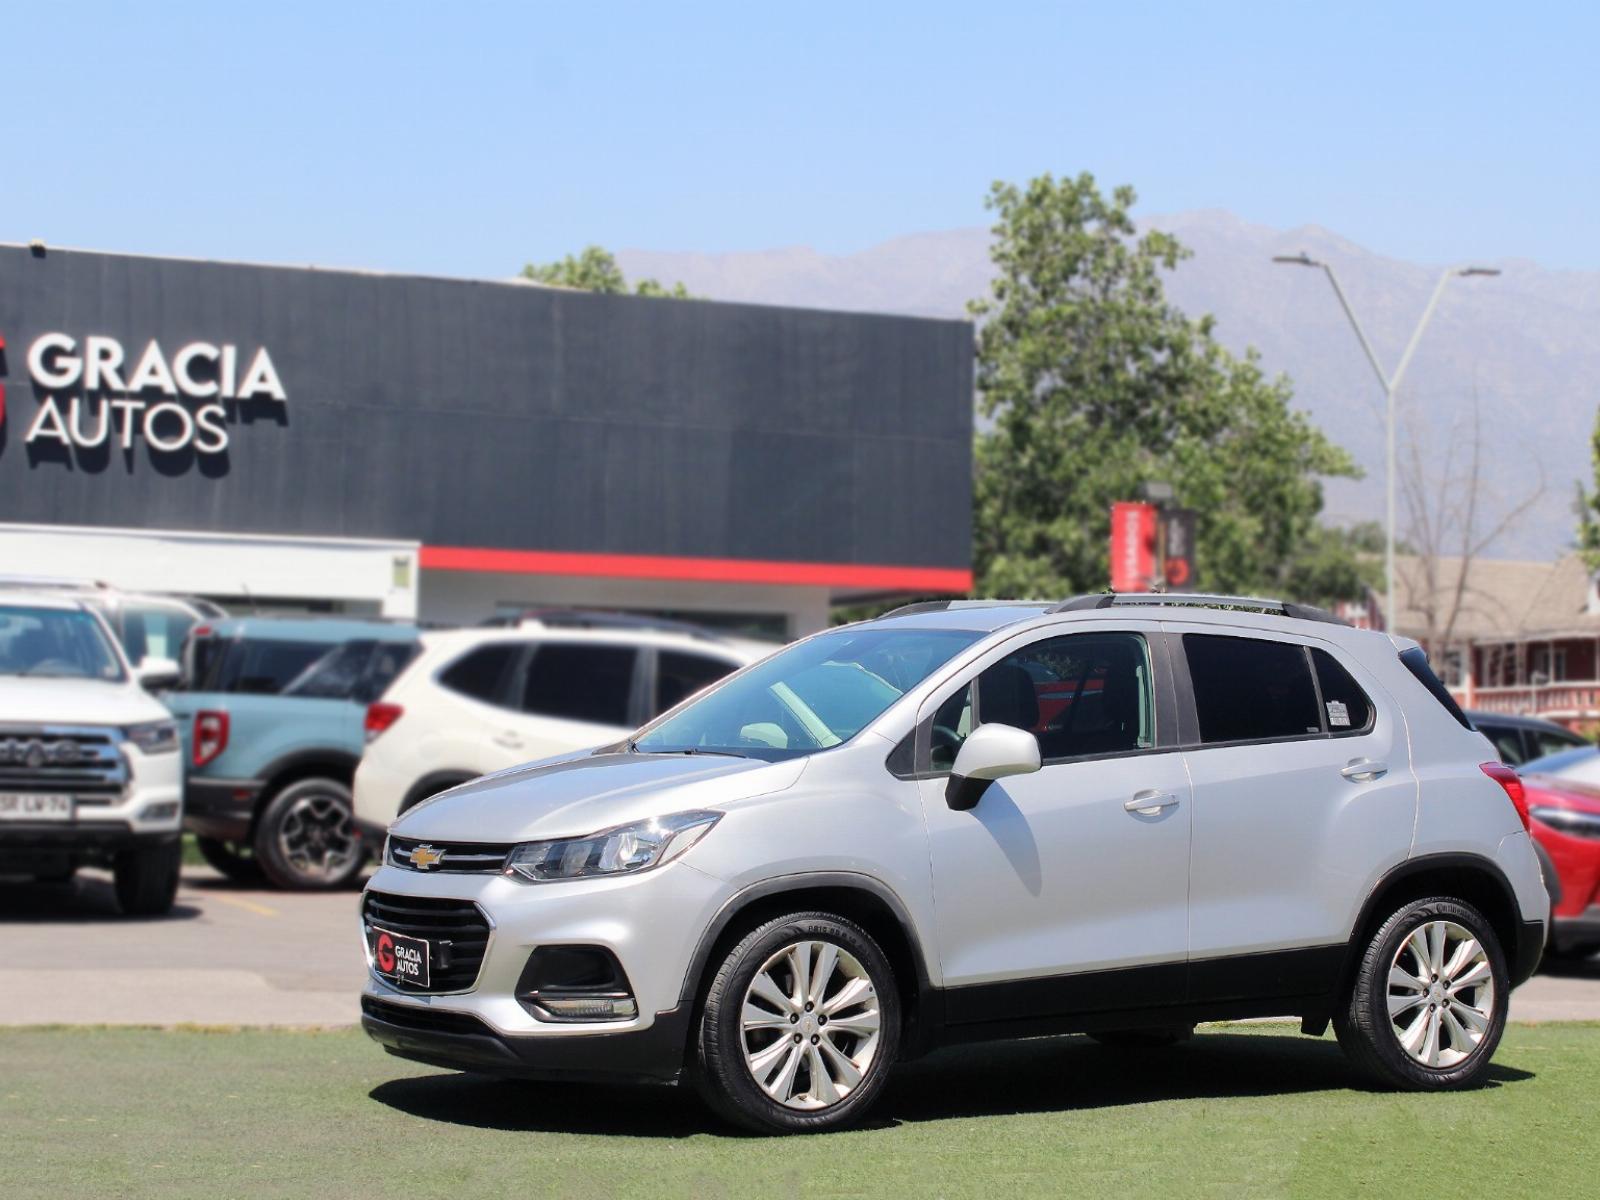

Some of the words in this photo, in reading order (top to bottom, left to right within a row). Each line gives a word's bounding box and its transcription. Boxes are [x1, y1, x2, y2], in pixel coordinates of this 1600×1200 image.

[27, 332, 287, 400] GRACIA
[25, 396, 229, 453] AUTOS
[395, 945, 422, 964] GRACIA
[397, 959, 419, 976] AUTOS
